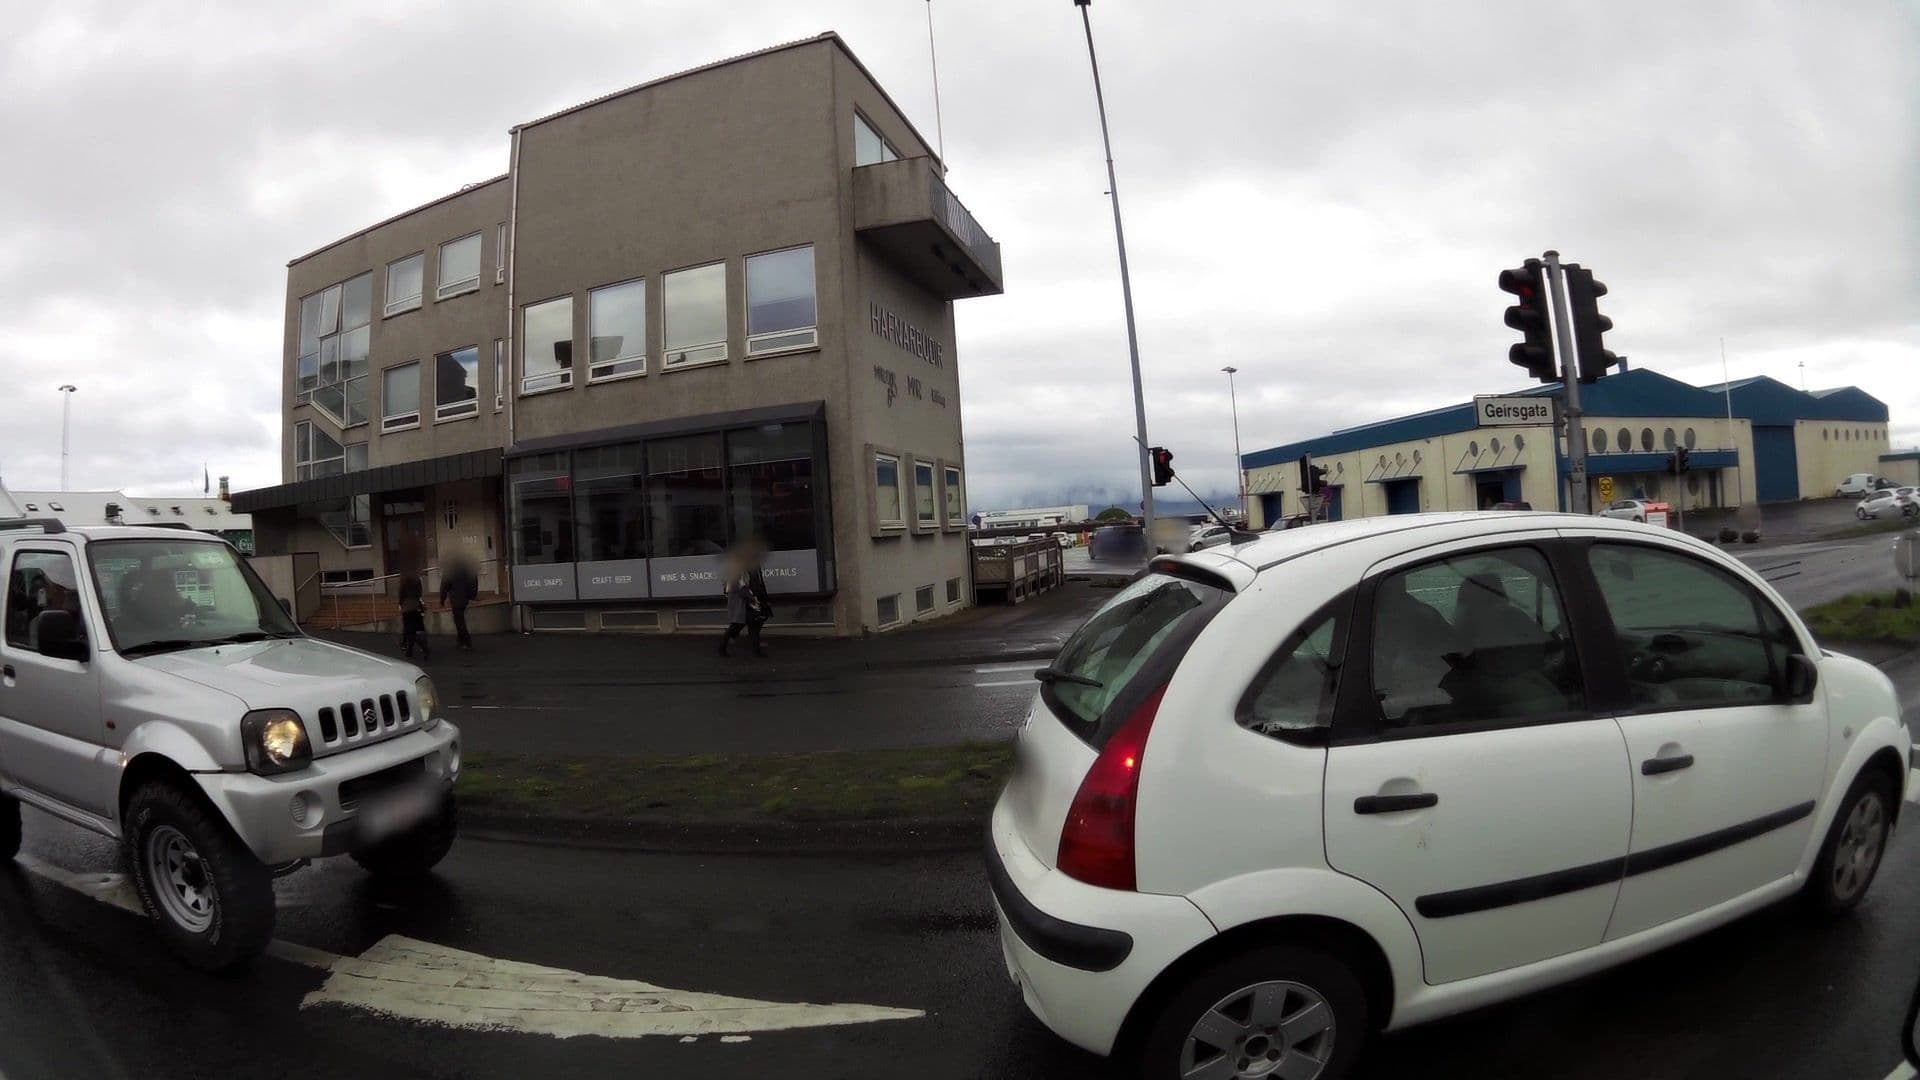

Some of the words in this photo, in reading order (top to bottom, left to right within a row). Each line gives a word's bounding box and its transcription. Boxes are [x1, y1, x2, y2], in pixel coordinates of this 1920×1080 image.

[1485, 404, 1547, 420] Geirsgata
[591, 576, 612, 585] CRAFT
[615, 575, 632, 584] BEER
[660, 572, 678, 582] WINE
[680, 573, 687, 581] &
[524, 579, 542, 588] LOCAL
